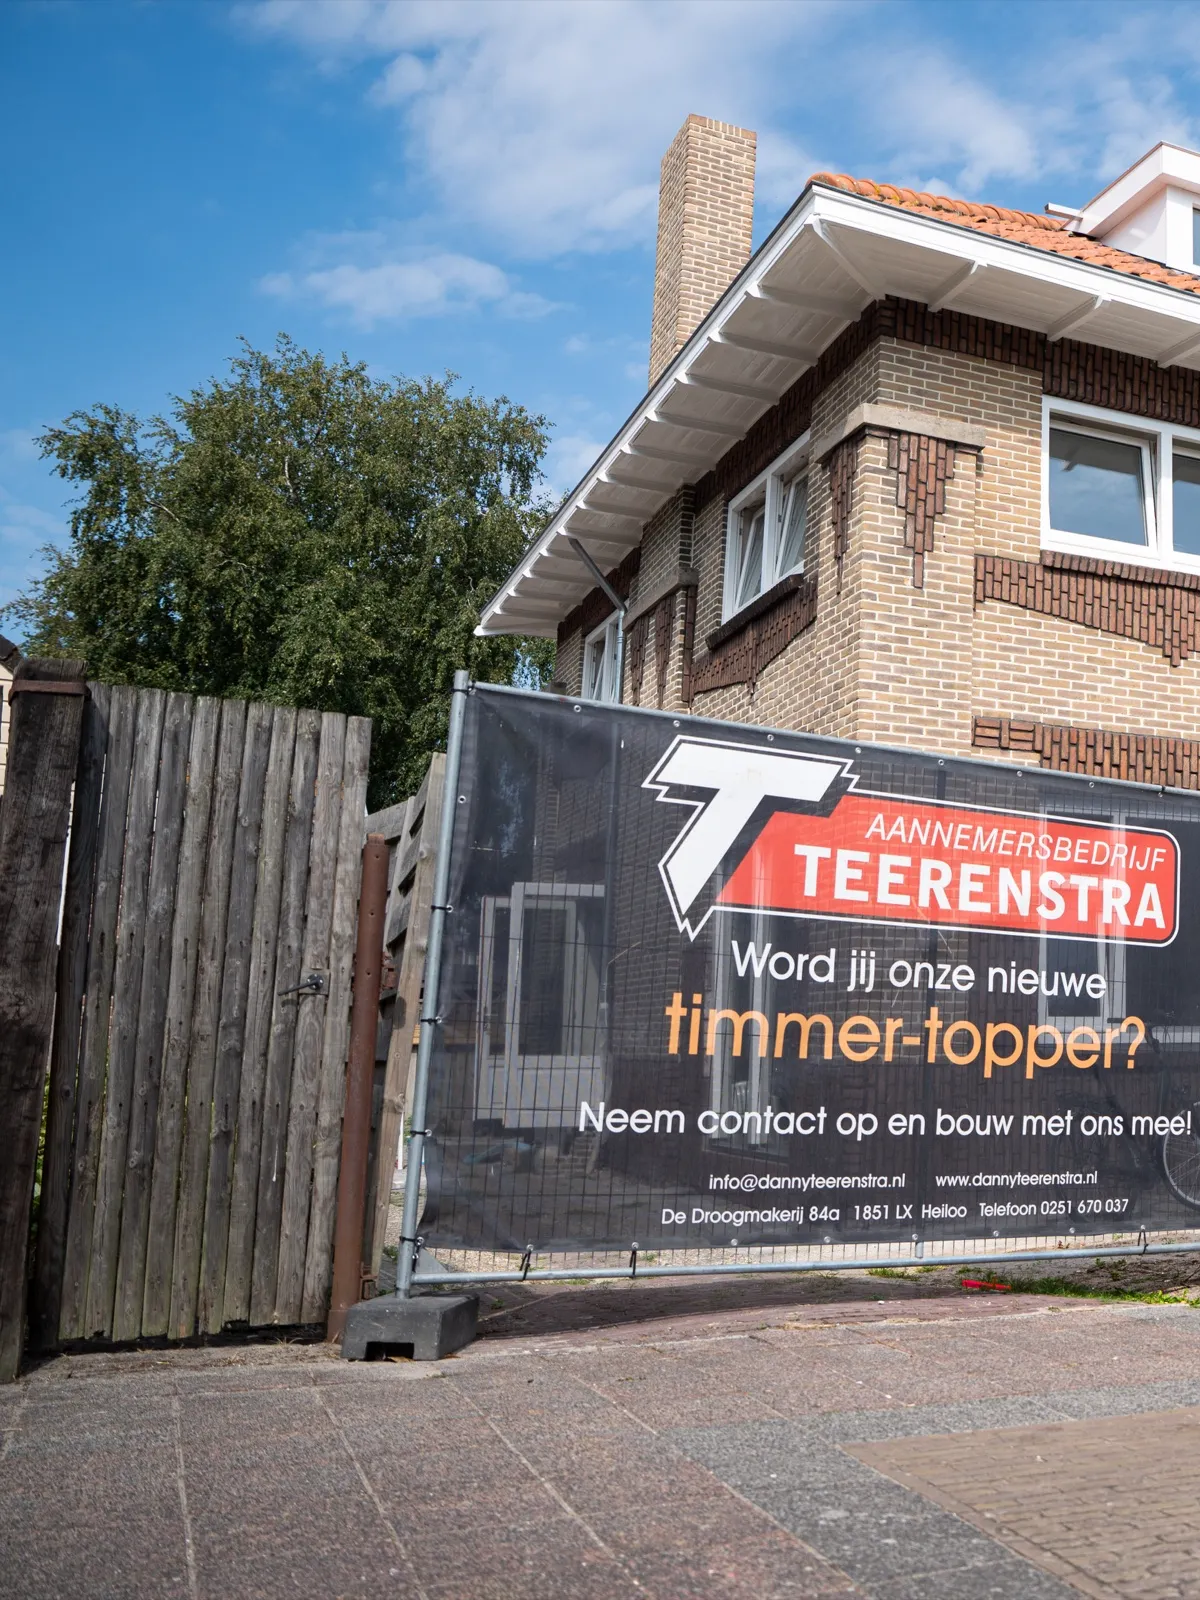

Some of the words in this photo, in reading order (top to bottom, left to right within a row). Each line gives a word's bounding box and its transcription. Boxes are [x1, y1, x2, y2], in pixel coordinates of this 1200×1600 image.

[865, 813, 1166, 872] AANNEMERSBEDRIJF
[794, 844, 1165, 928] TEERENSTRA
[731, 940, 836, 982] Word
[847, 949, 876, 992] jij
[888, 960, 975, 991] onze
[988, 961, 1106, 998] nieuwe
[665, 992, 1145, 1078] timmer-topper?
[578, 1101, 685, 1133] Neem
[697, 1105, 827, 1135] contact
[836, 1112, 878, 1141] op
[888, 1113, 925, 1135] en
[935, 1108, 1014, 1136] bouw
[1022, 1110, 1073, 1135] met
[1080, 1115, 1123, 1135] ons
[1131, 1110, 1192, 1135] mee!
[709, 1173, 905, 1191] info@dannyteerenstra.nl
[936, 1171, 1098, 1188] www.dannyteerenstra.nl
[661, 1208, 686, 1224] De
[692, 1206, 804, 1226] Droogmakerij
[809, 1206, 840, 1222] 84a
[854, 1204, 889, 1220] 1851
[895, 1204, 913, 1219] LX
[921, 1203, 967, 1219] Heiloo
[979, 1201, 1036, 1217] Telefoon
[1040, 1200, 1072, 1215] 0251
[1077, 1199, 1101, 1214] 670
[1105, 1198, 1129, 1213] 037
